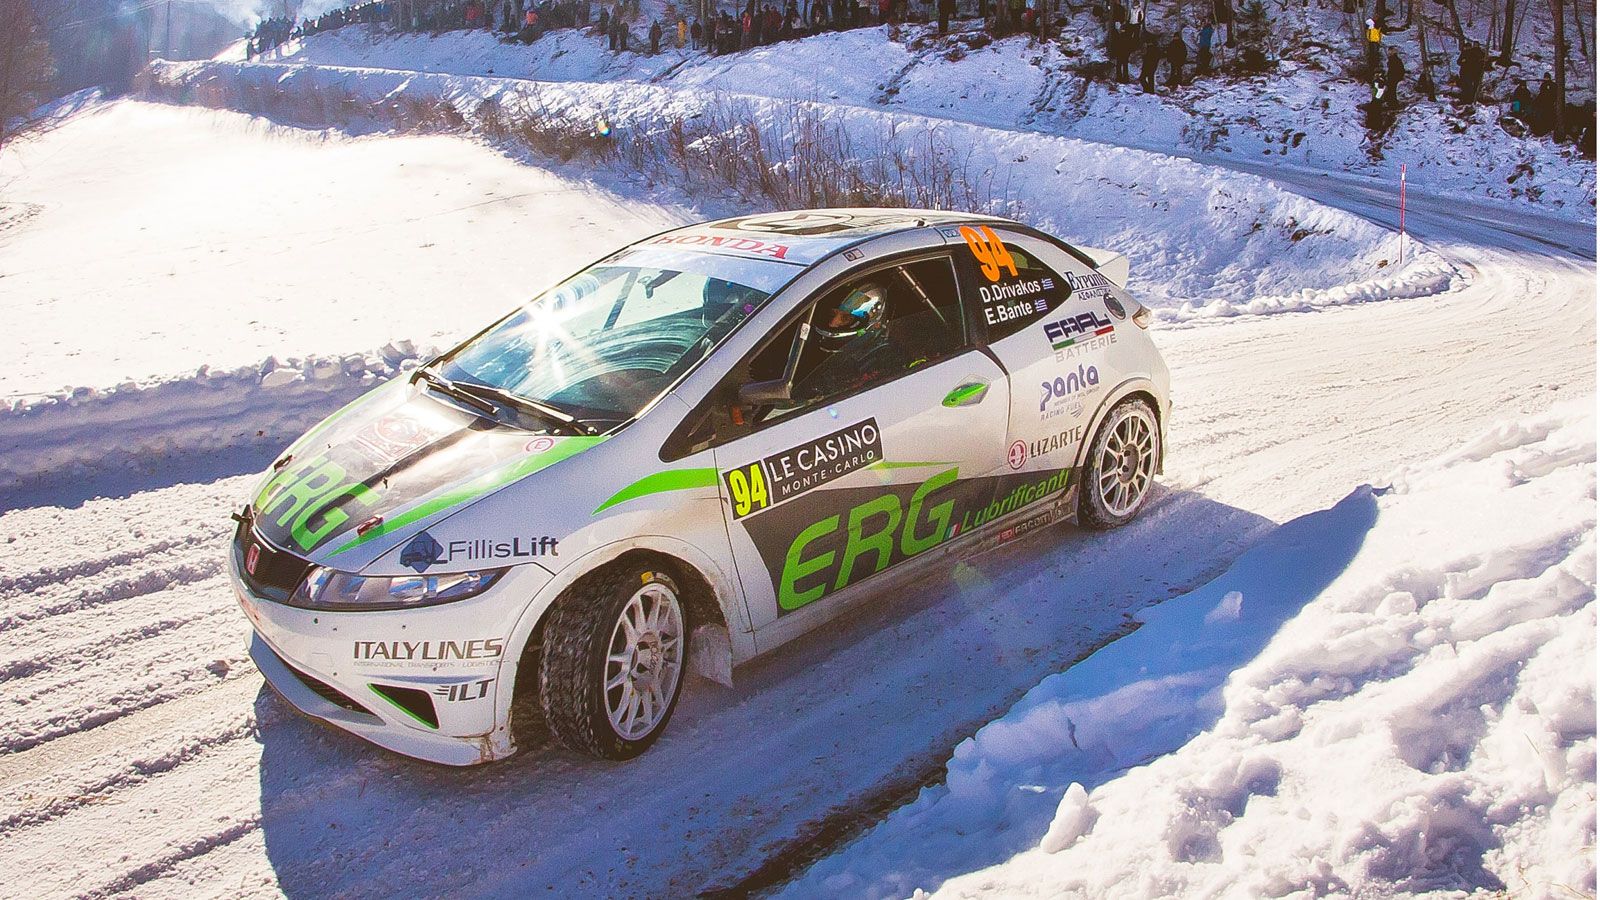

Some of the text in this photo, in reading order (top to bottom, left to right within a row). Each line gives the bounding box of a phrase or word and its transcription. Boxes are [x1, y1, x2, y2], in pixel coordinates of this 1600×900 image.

[652, 234, 790, 260] HONDA
[959, 225, 1018, 282] 94
[979, 278, 1041, 304] D.Drivakos
[984, 301, 1033, 326] E.Bante
[1055, 333, 1118, 364] BATTERIE
[1040, 363, 1099, 412] panta
[772, 424, 877, 484] LE CASINO
[1030, 425, 1082, 459] LIZARTE
[255, 456, 381, 551] ERG
[730, 463, 768, 517] 94
[960, 469, 1070, 532] Lubrificanti
[778, 467, 959, 610] ERG
